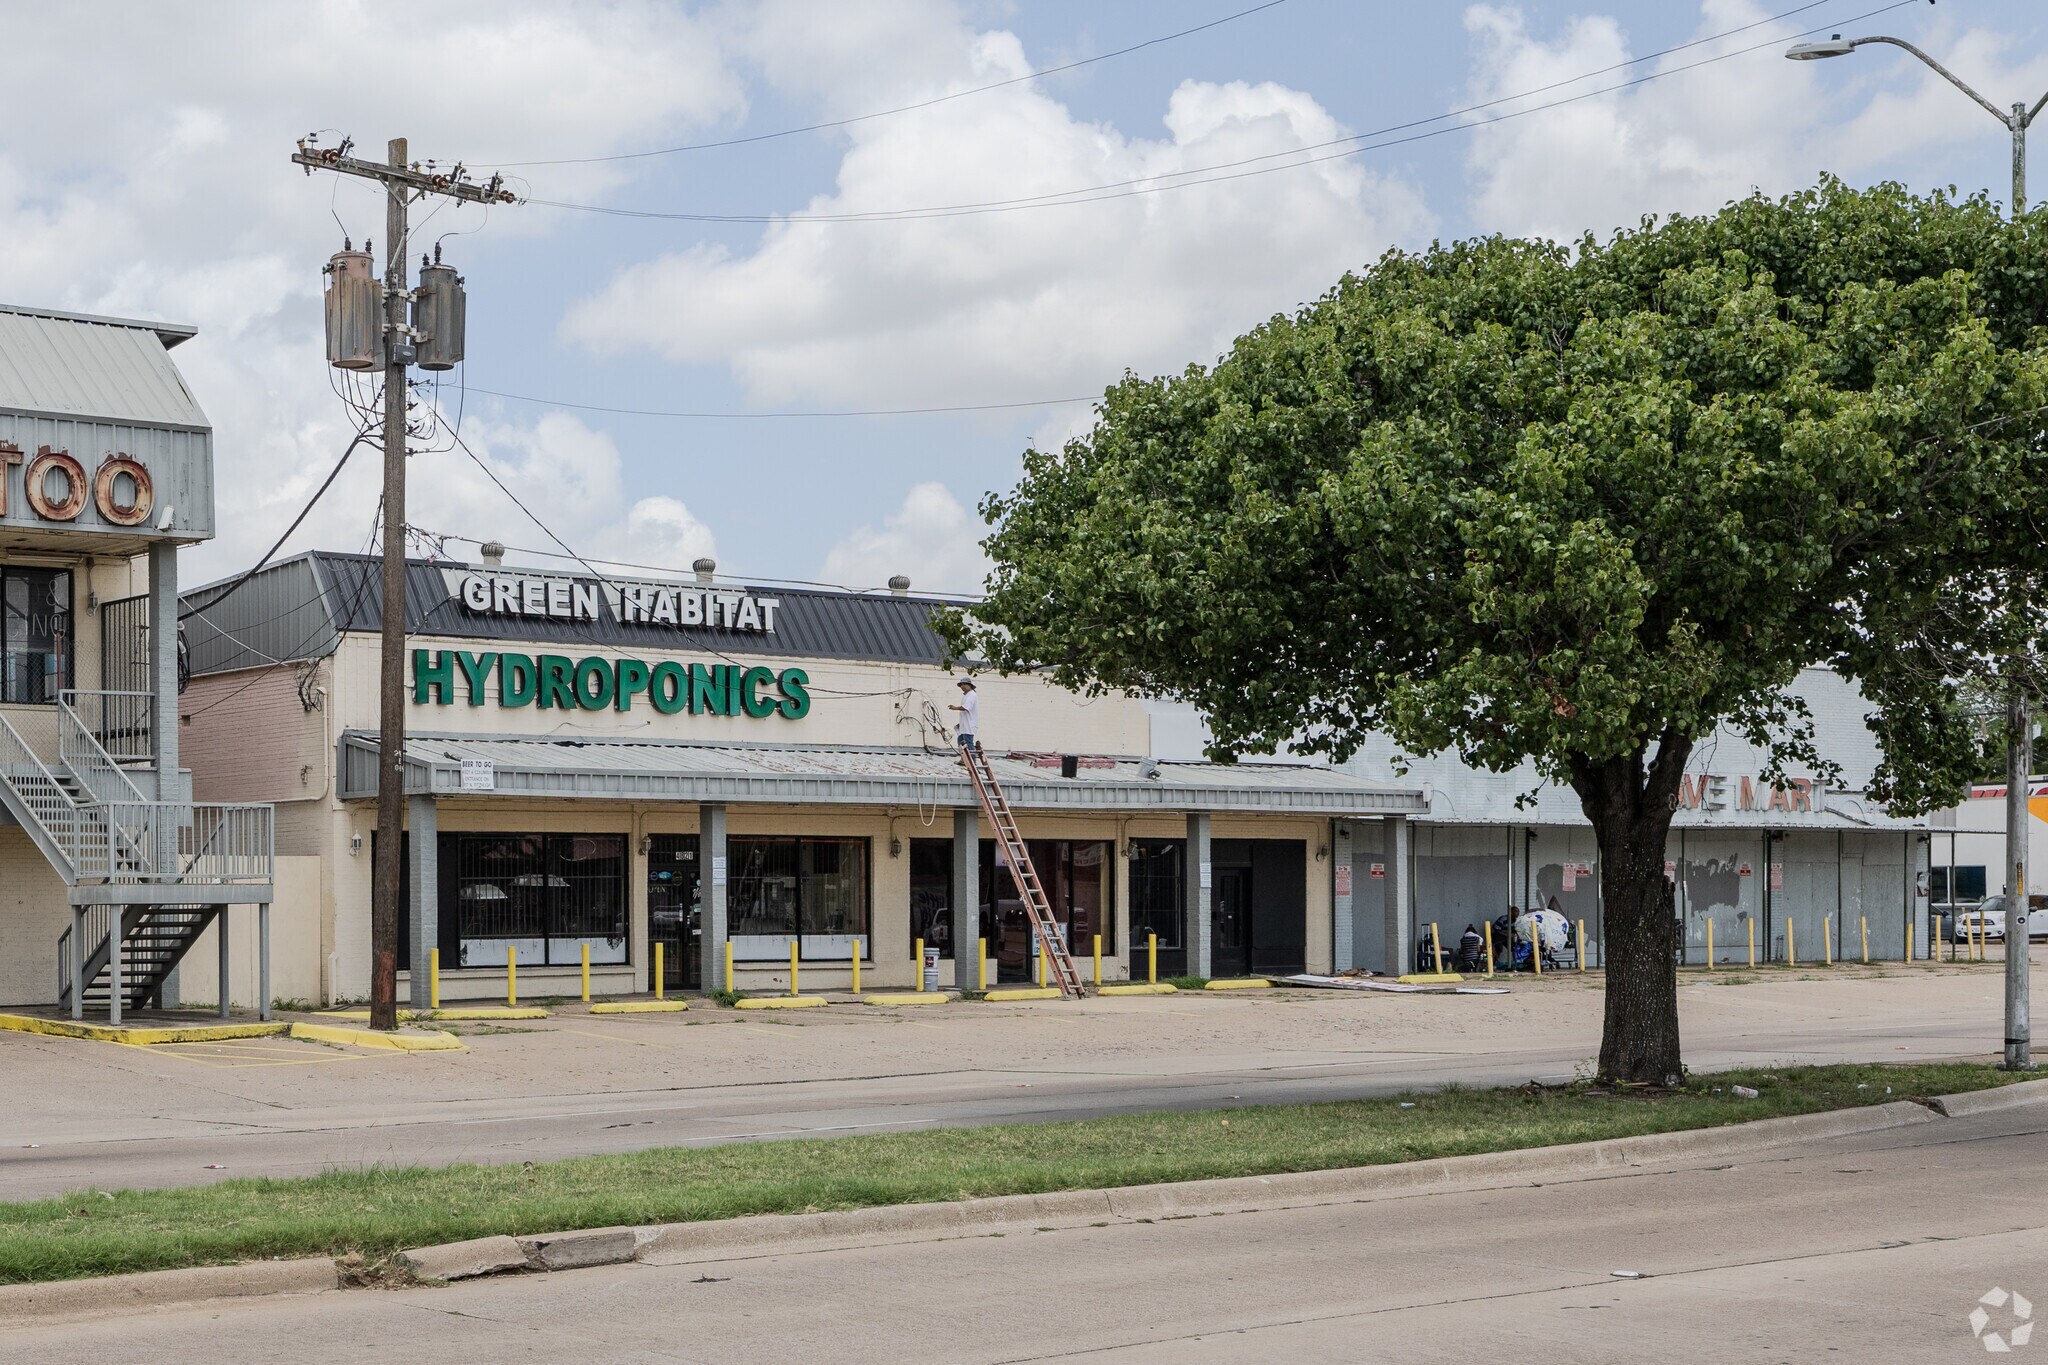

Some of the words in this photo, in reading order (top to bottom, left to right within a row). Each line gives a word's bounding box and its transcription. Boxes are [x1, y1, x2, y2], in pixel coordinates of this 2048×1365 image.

[460, 576, 599, 620] GREEN
[622, 586, 780, 633] HABITAT
[413, 648, 811, 721] HYDROPONICS
[462, 760, 474, 768] BEER
[475, 760, 482, 768] TO
[1678, 773, 1727, 811] VE
